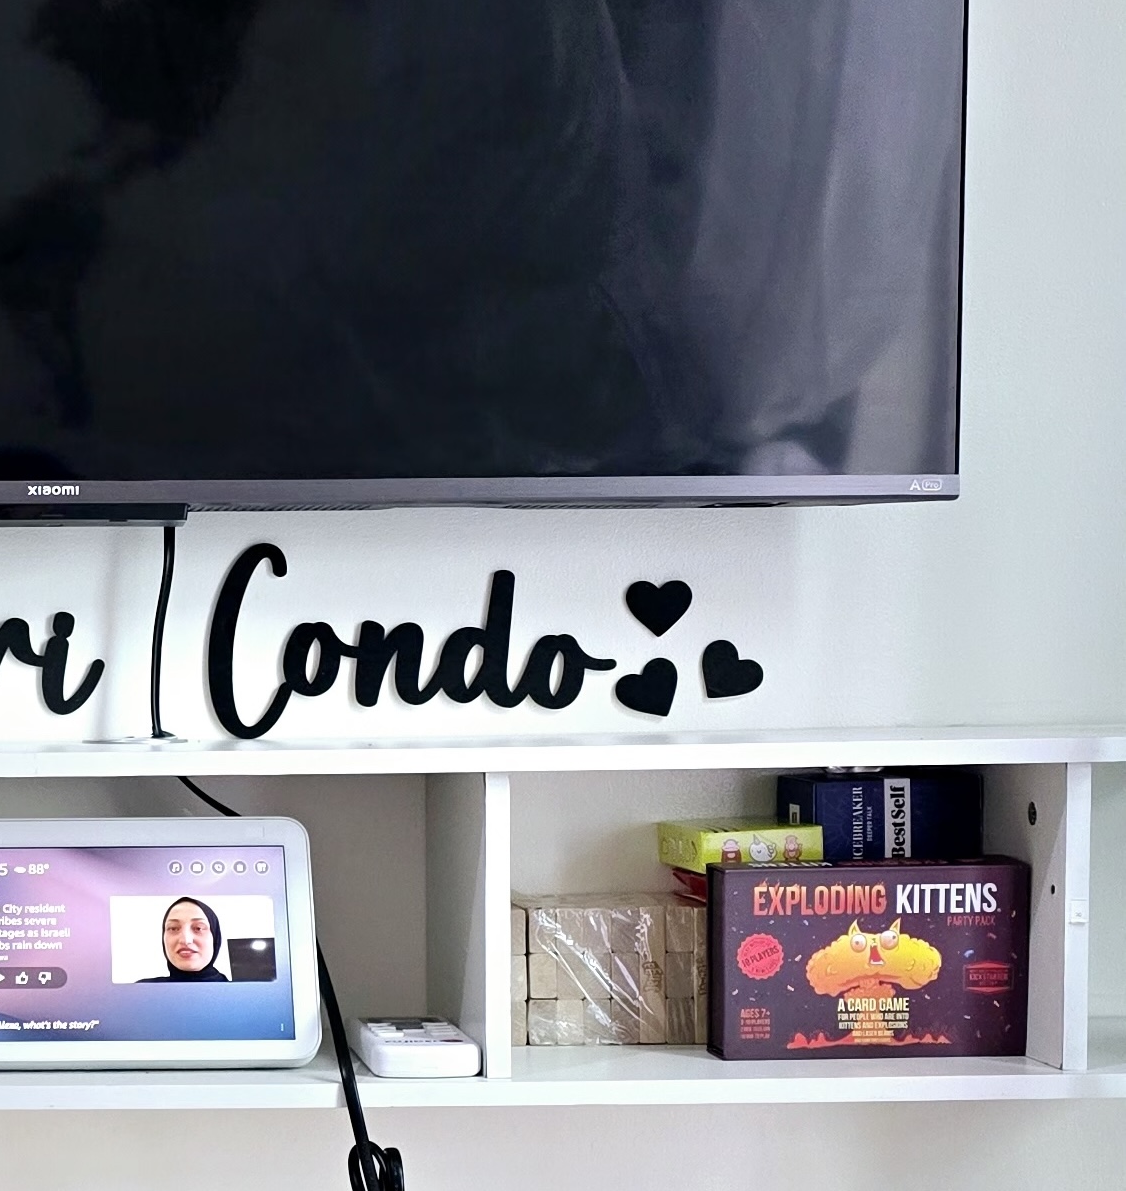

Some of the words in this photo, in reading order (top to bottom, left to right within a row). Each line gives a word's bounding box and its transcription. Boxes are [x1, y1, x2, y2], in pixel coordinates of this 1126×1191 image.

[909, 479, 921, 491] A
[207, 542, 617, 740] Condo
[852, 786, 864, 860] ICEBREAKER
[889, 785, 906, 859] BestSelf
[753, 882, 887, 916] EXPLODING
[896, 882, 999, 914] KITTENS
[2, 904, 23, 916] City
[25, 903, 66, 914] resident
[24, 917, 57, 926] severe
[947, 915, 974, 927] PARTY
[975, 915, 996, 926] PACK
[27, 929, 39, 938] as
[40, 928, 71, 938] Israeli
[12, 940, 33, 950] rain
[34, 940, 63, 950] down
[750, 945, 780, 963] PLAYERS
[837, 998, 846, 1012] A
[847, 997, 877, 1012] CARD
[878, 997, 910, 1012] GAME
[740, 1008, 761, 1019] AGES
[761, 1008, 771, 1019] 7+
[837, 1012, 849, 1021] FOR
[849, 1012, 870, 1021] PEOPLE
[52, 1020, 68, 1030] the
[874, 1021, 909, 1030] EXPLOSIONS
